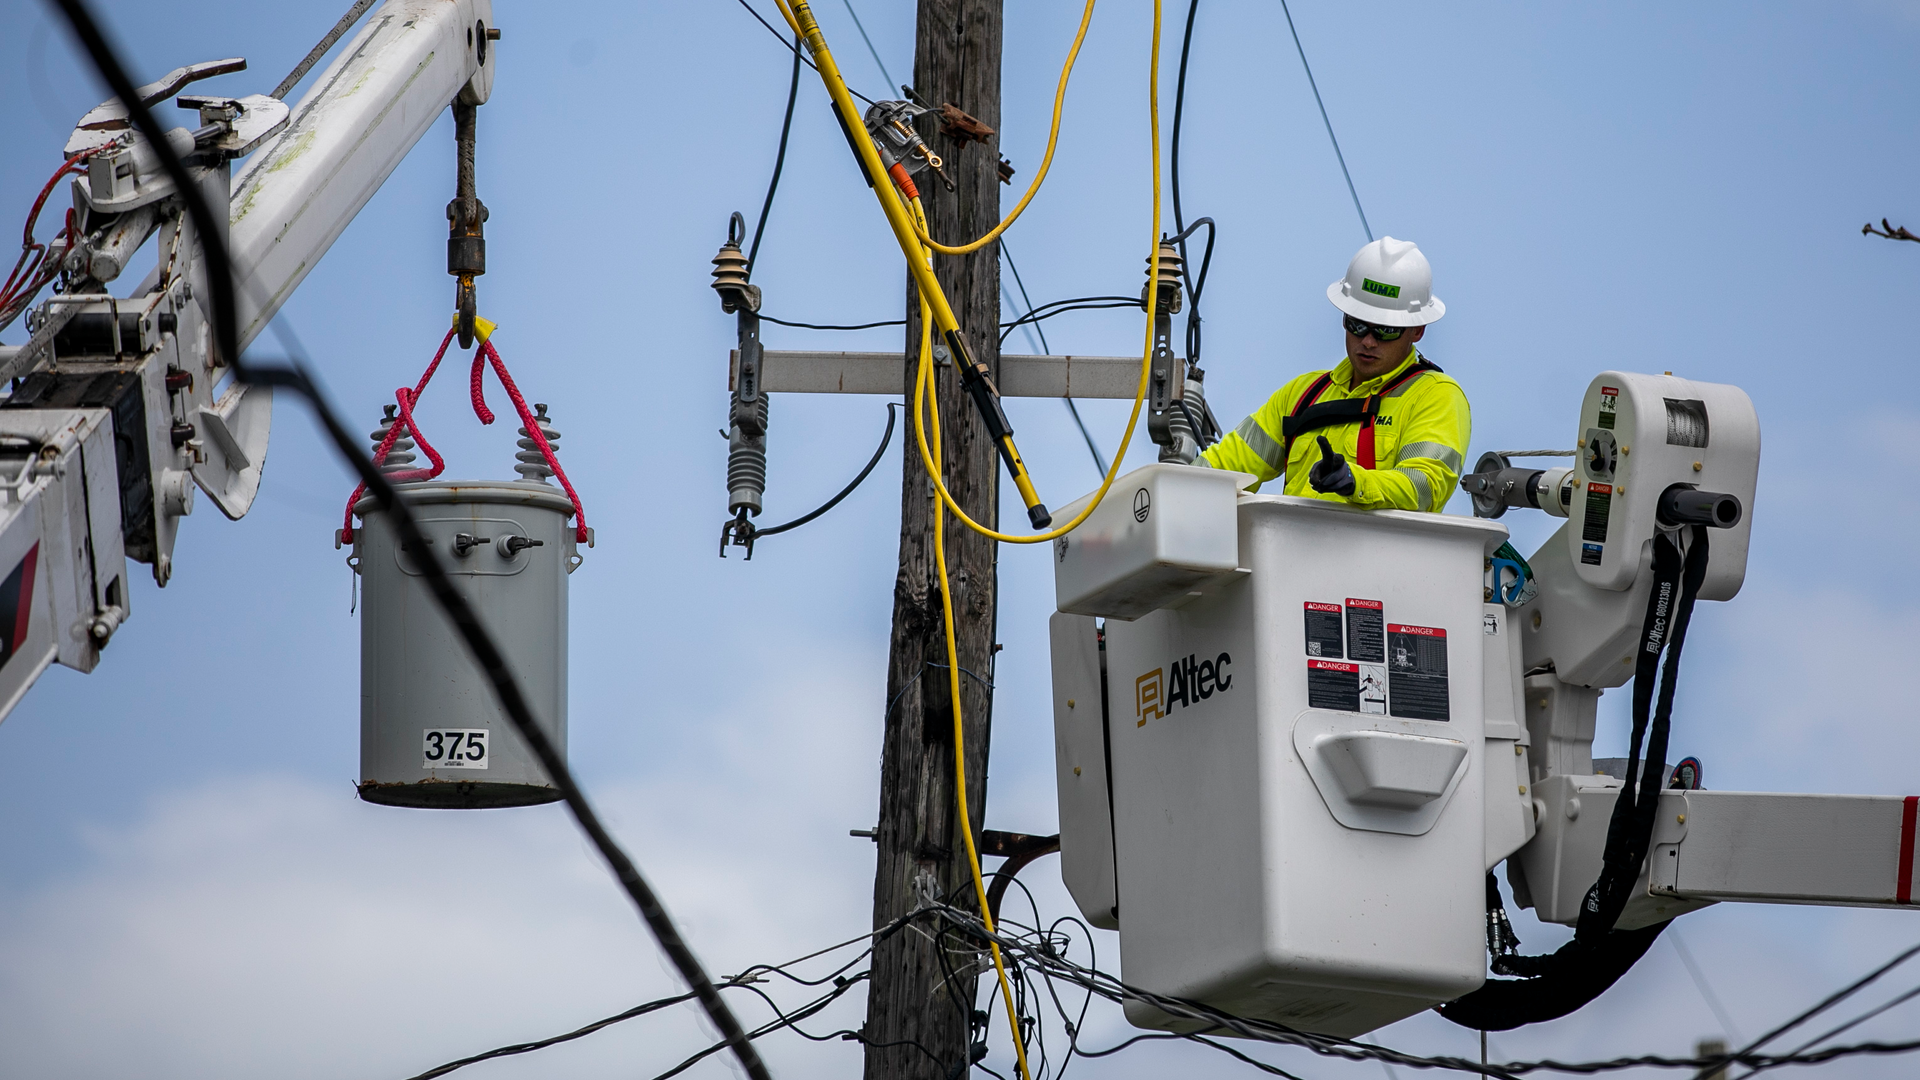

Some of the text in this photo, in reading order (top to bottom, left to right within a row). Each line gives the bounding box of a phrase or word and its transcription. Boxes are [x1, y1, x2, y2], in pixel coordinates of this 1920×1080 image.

[1364, 281, 1396, 297] LUMA
[1375, 415, 1392, 426] MA
[1312, 603, 1339, 612] DANGER
[1355, 599, 1379, 607] DANGER
[1406, 626, 1434, 635] DANGER
[1649, 618, 1666, 645] Altec
[1322, 661, 1351, 671] DANGER
[1165, 652, 1232, 716] Altec
[425, 731, 485, 761] 37.5
